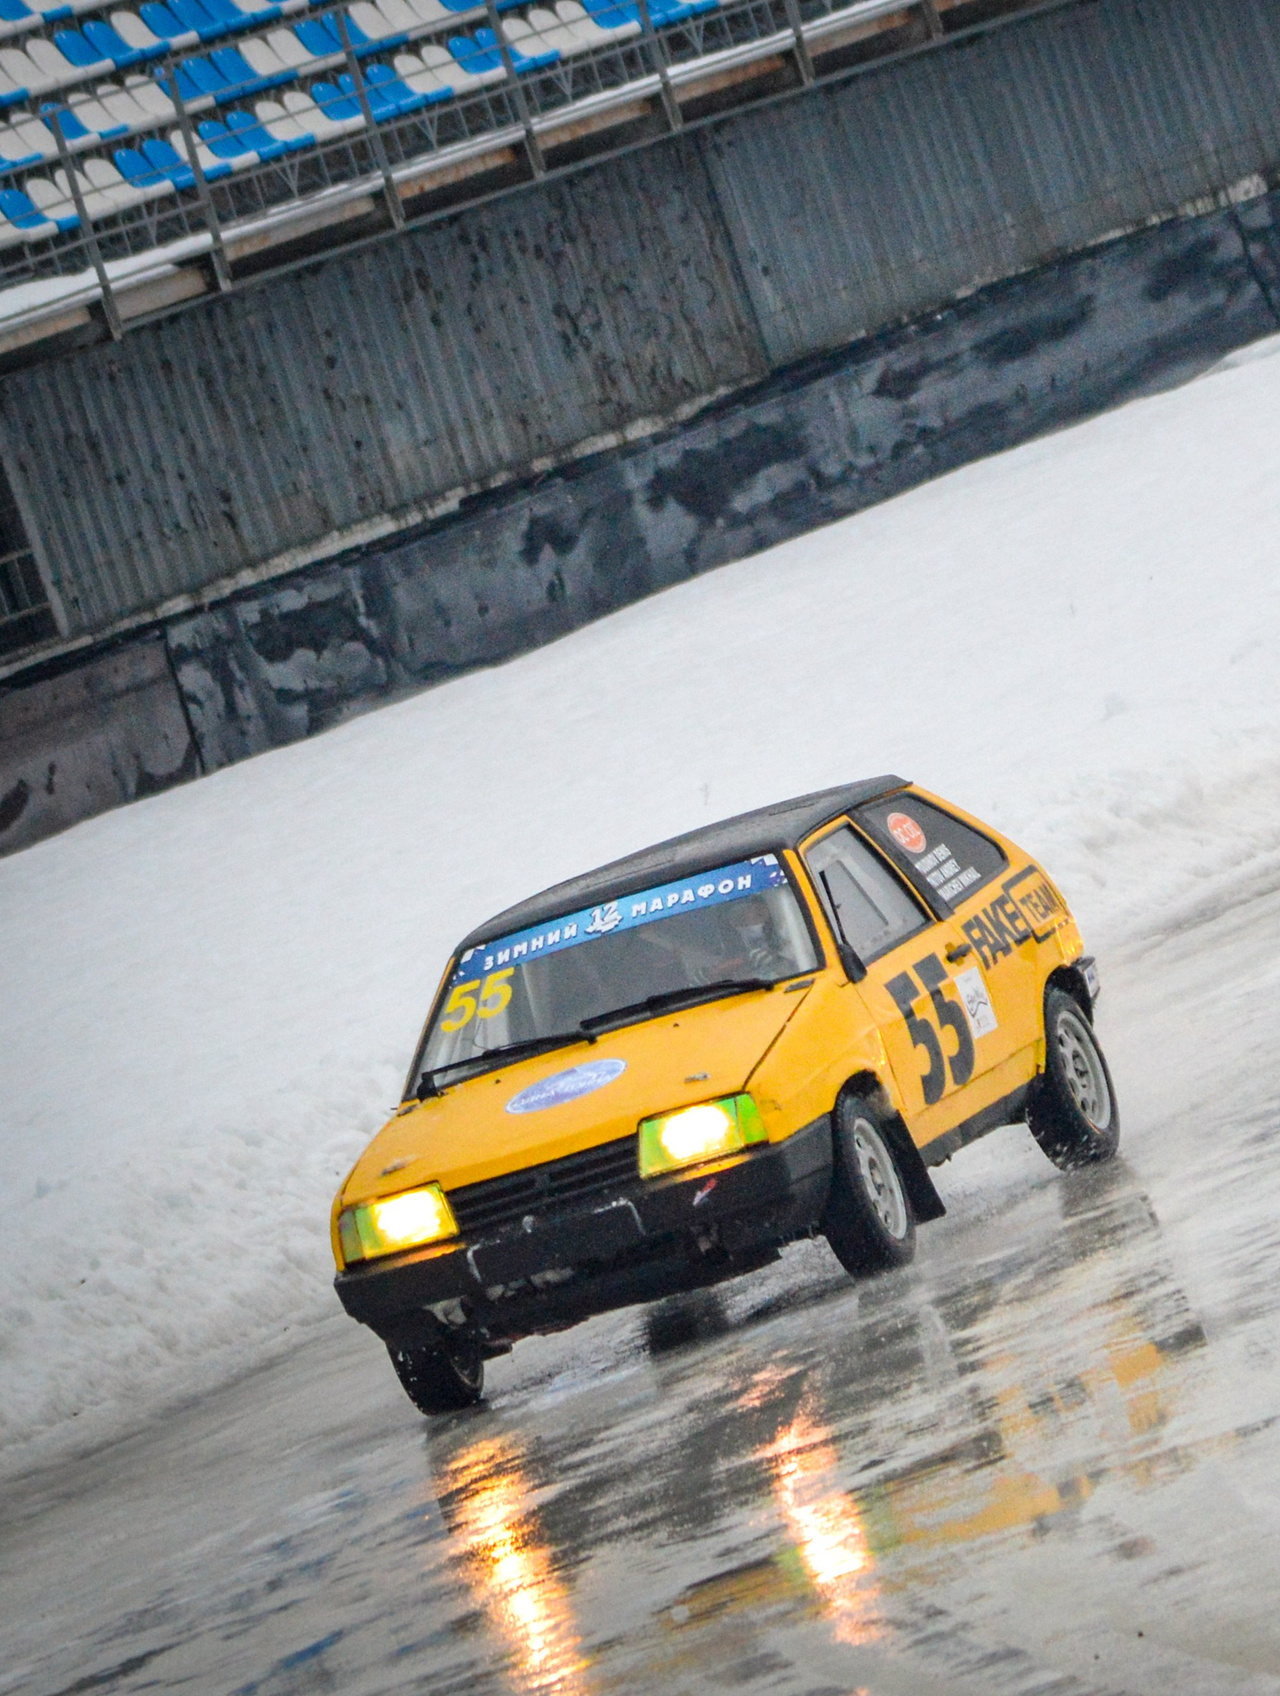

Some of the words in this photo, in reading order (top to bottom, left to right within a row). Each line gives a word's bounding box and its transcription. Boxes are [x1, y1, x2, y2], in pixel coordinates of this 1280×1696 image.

[483, 922, 578, 971] ЗИМНИЙ
[631, 874, 752, 918] МАРАФОН
[961, 892, 1032, 970] FAKE
[1019, 882, 1064, 924] TEAM
[440, 968, 515, 1033] 55
[884, 952, 976, 1105] 55
